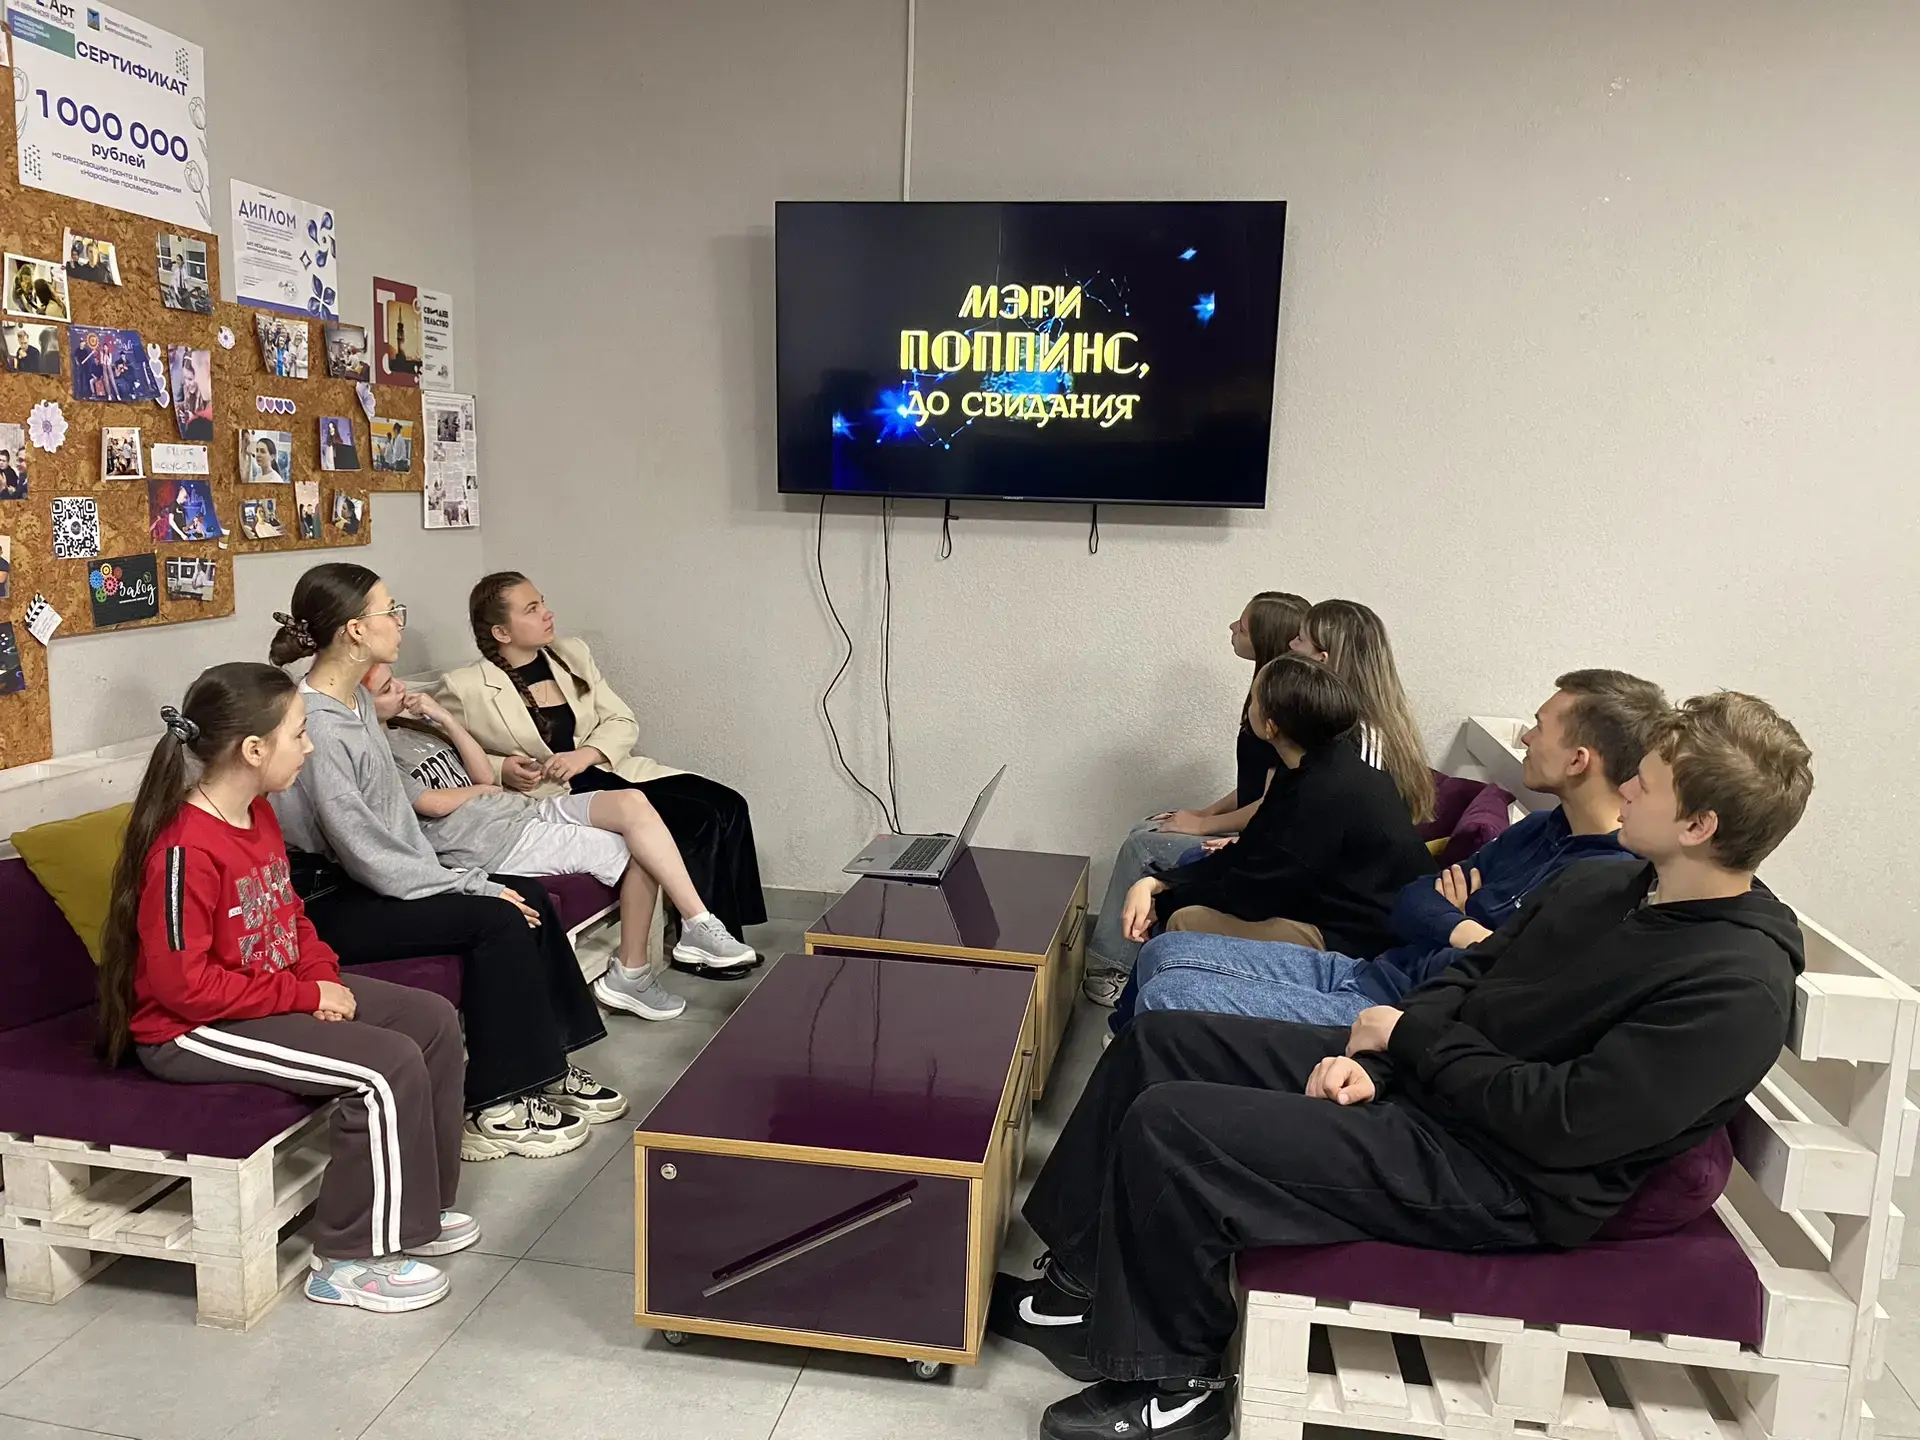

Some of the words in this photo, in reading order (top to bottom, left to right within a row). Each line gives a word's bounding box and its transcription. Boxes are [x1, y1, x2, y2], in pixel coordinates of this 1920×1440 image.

[76, 41, 188, 96] СЕРТИФИКАТ
[36, 89, 49, 118] 1
[57, 96, 123, 141] 000
[130, 121, 189, 162] 000
[91, 143, 146, 169] рублей
[109, 168, 134, 181] гранта
[239, 199, 296, 229] ДИПЛОМ
[958, 284, 1082, 319] МЭРИ
[900, 330, 1151, 379] ПОППИНС,
[905, 390, 950, 426] ДО
[961, 391, 1141, 428] СВИДАНИЯ
